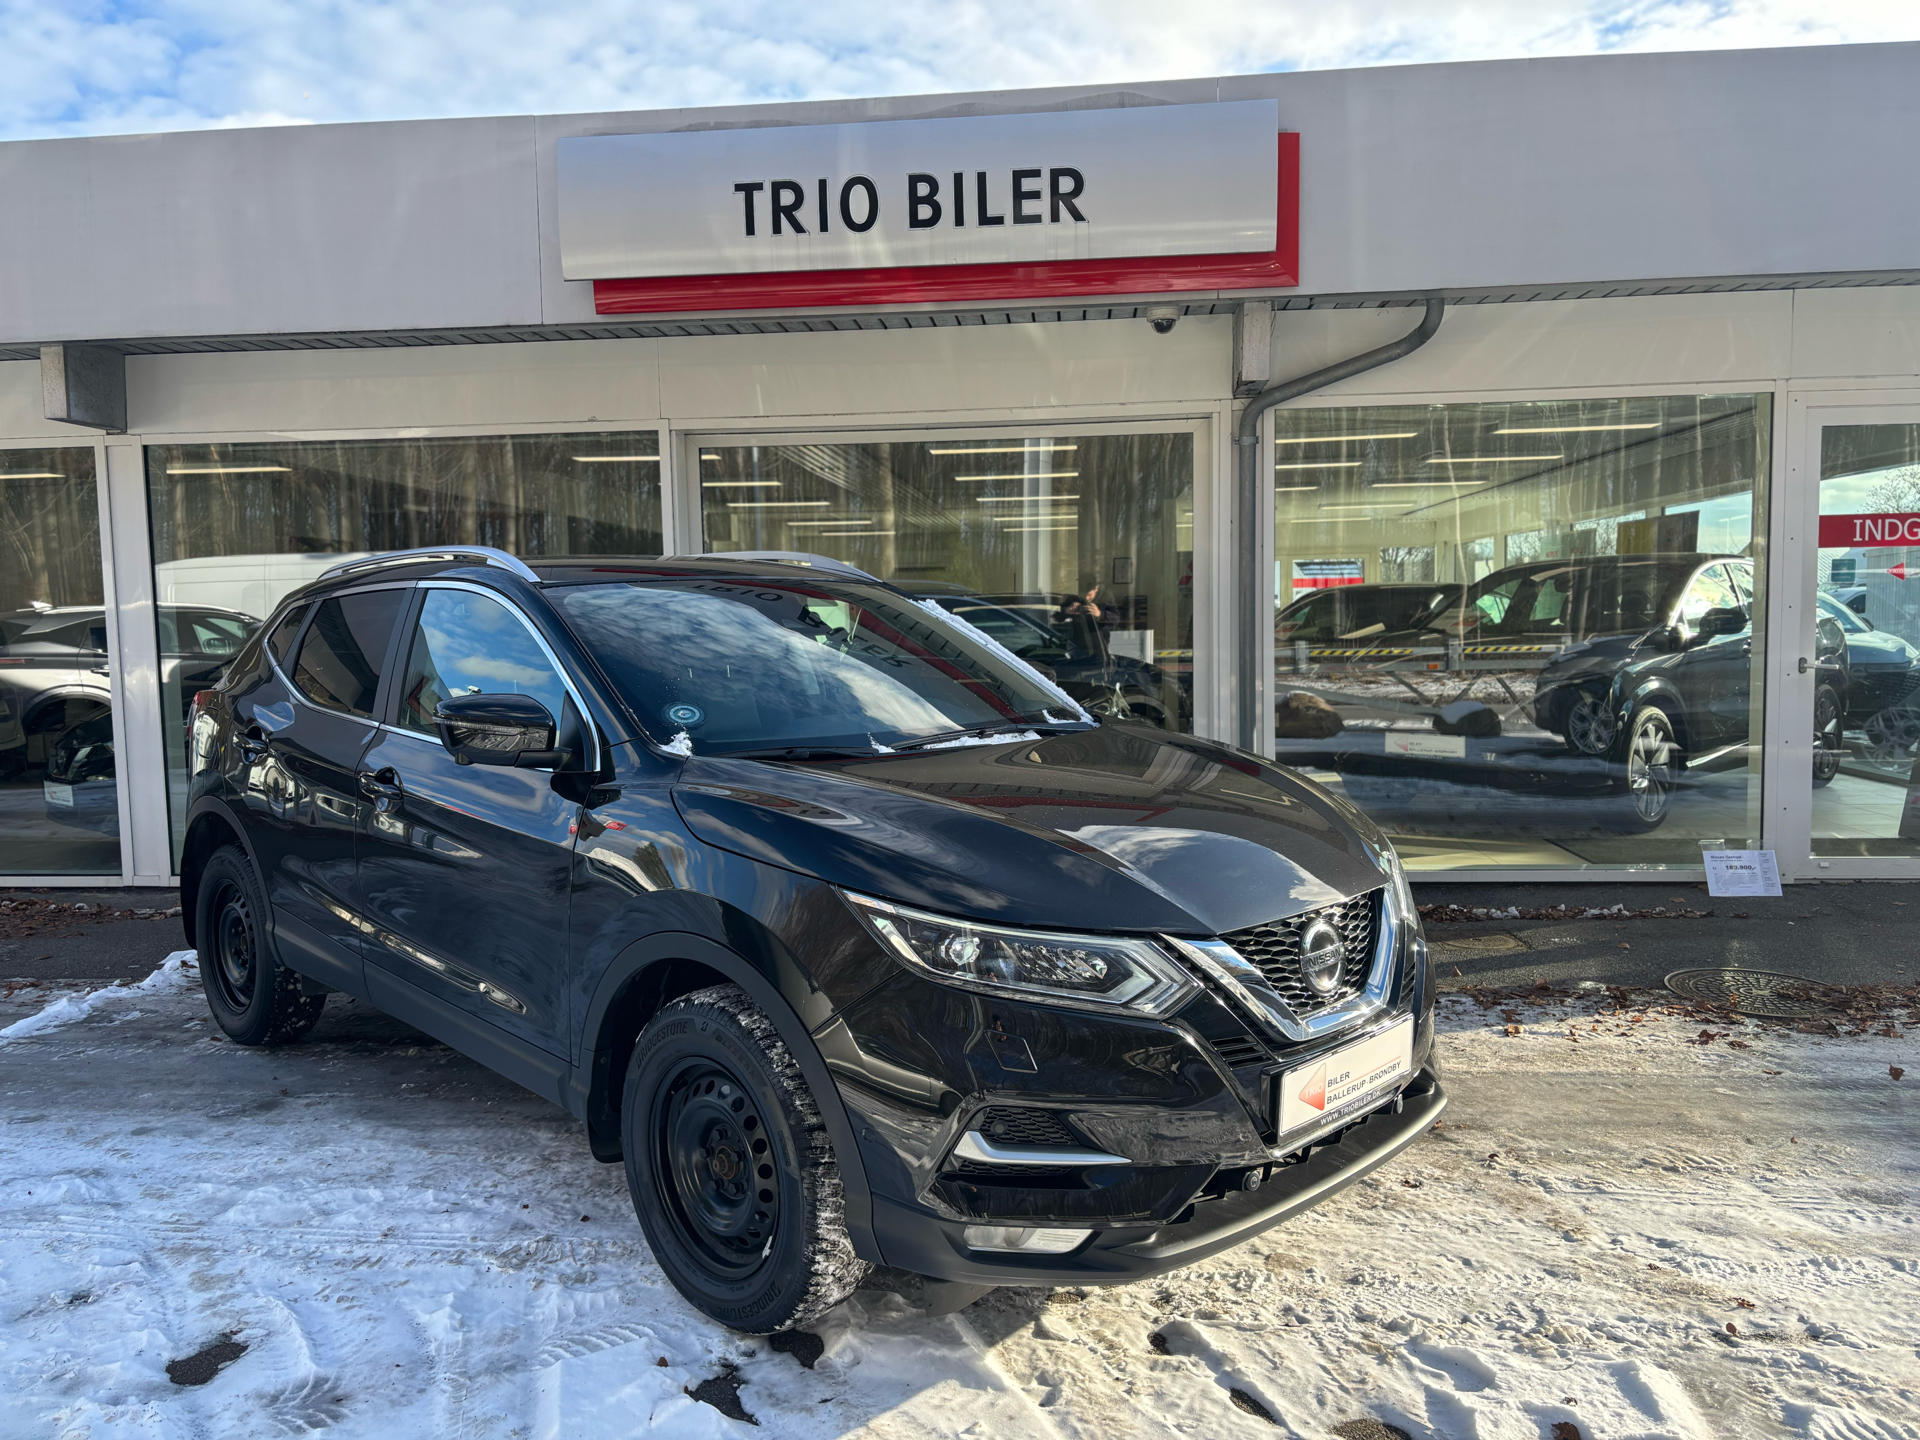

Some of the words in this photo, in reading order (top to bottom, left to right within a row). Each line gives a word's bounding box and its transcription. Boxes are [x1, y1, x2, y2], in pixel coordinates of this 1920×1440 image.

[733, 174, 880, 238] TRIO
[906, 165, 1090, 231] BILER
[1308, 947, 1341, 968] NISSAN
[636, 1021, 688, 1070] BRIDGESTONE
[1327, 1071, 1351, 1088] BILER
[1304, 1083, 1324, 1099] TRIO
